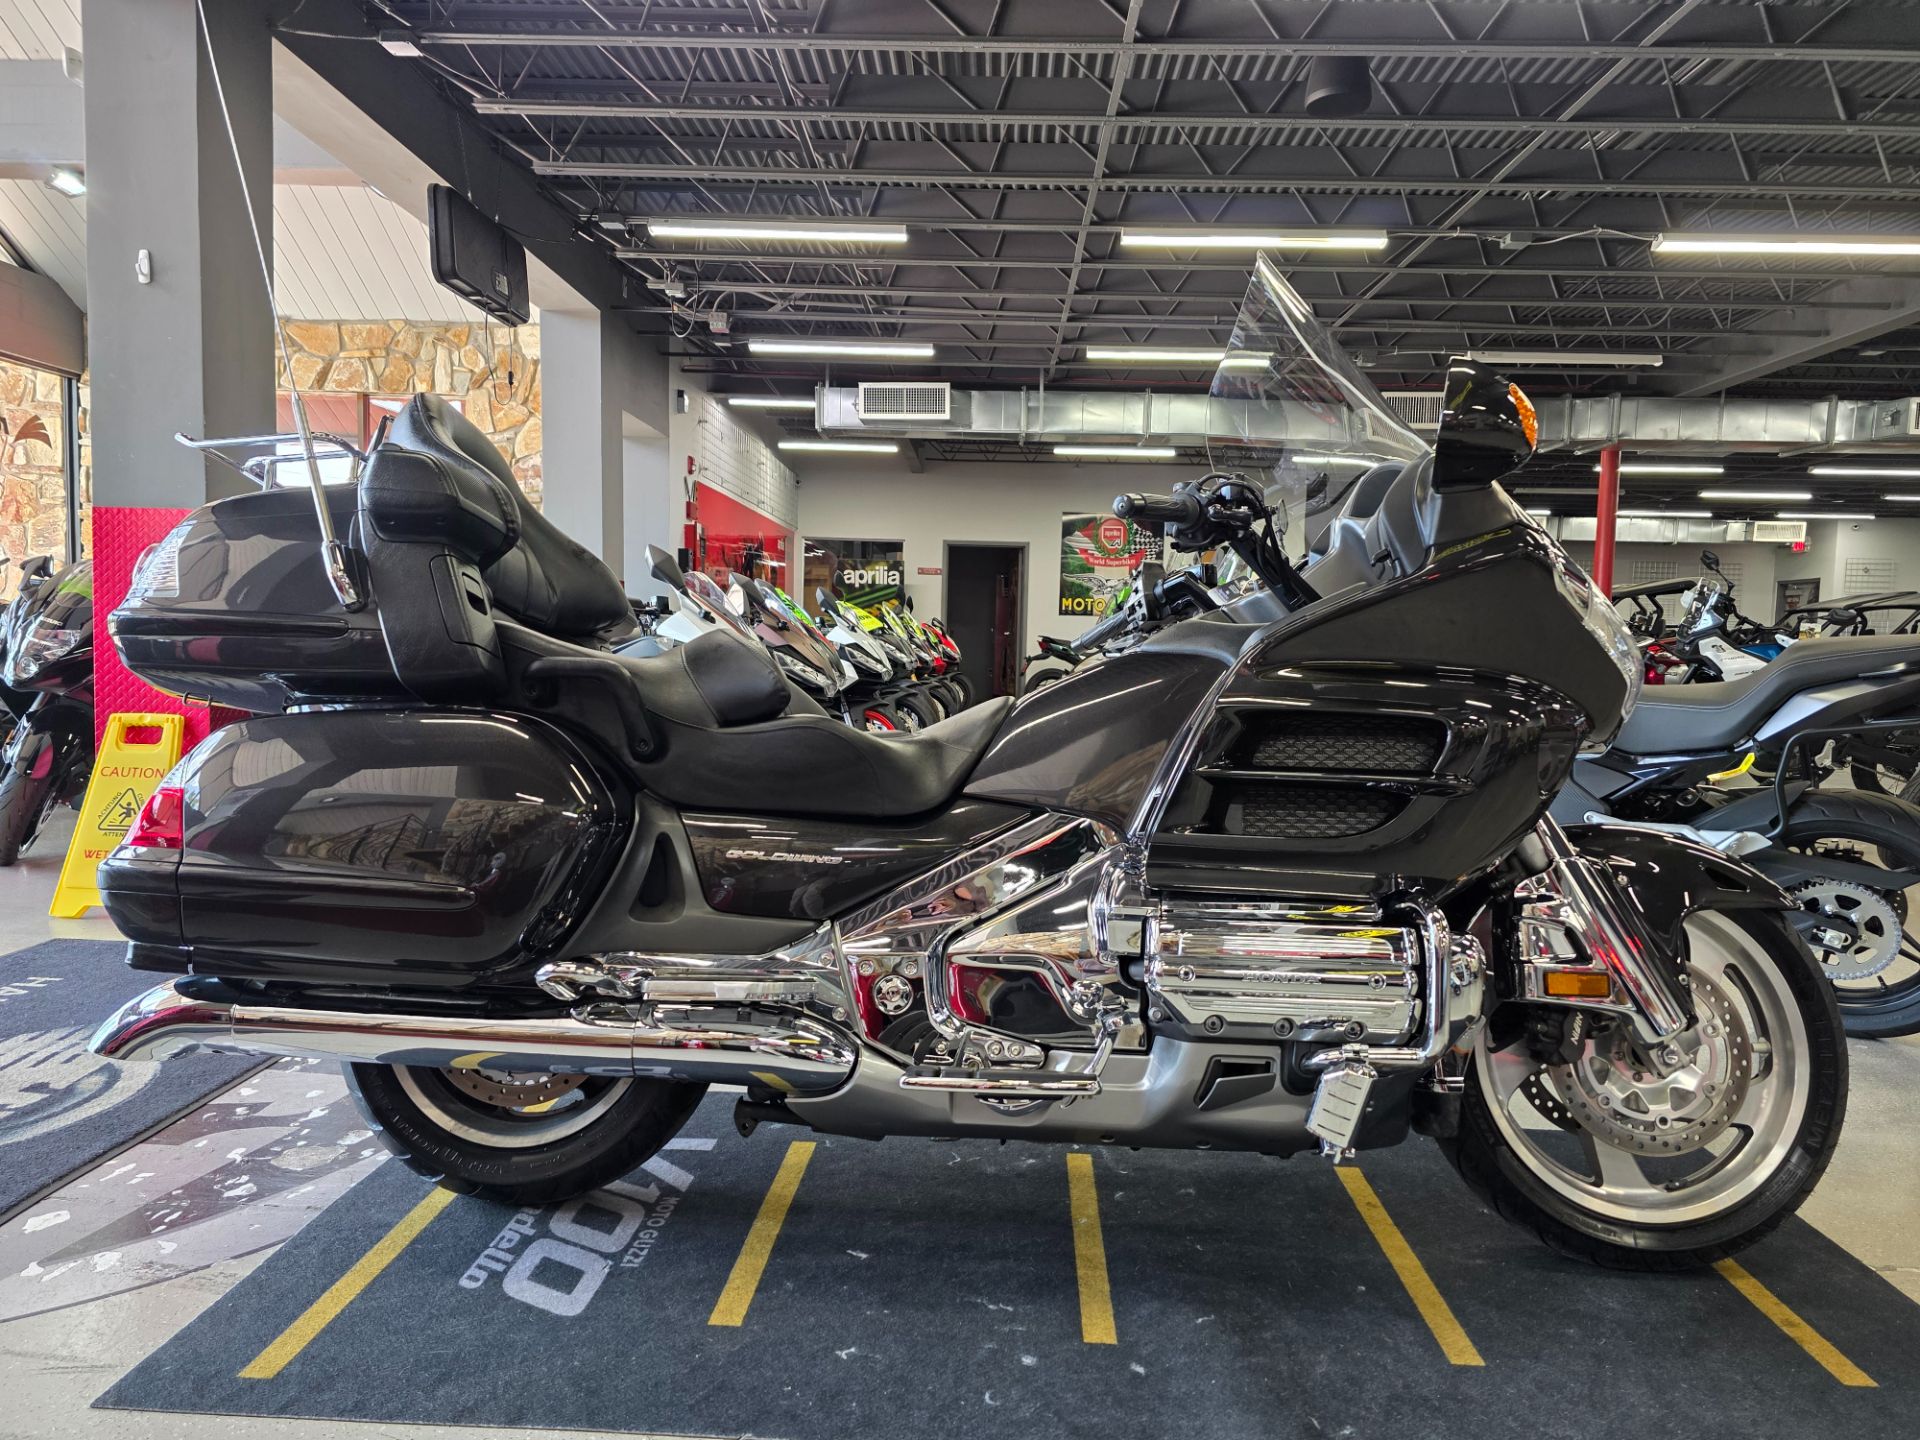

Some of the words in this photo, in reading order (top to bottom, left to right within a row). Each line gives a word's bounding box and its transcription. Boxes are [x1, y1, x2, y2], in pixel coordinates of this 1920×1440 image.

[843, 566, 900, 588] aprilia
[1062, 597, 1106, 612] MOTO
[100, 766, 165, 779] CAUTION
[97, 791, 122, 820] ACHTUNG
[84, 848, 110, 860] WET
[1241, 972, 1322, 986] HONDA
[646, 1196, 681, 1228] MOTO
[620, 1229, 658, 1269] GUZZI
